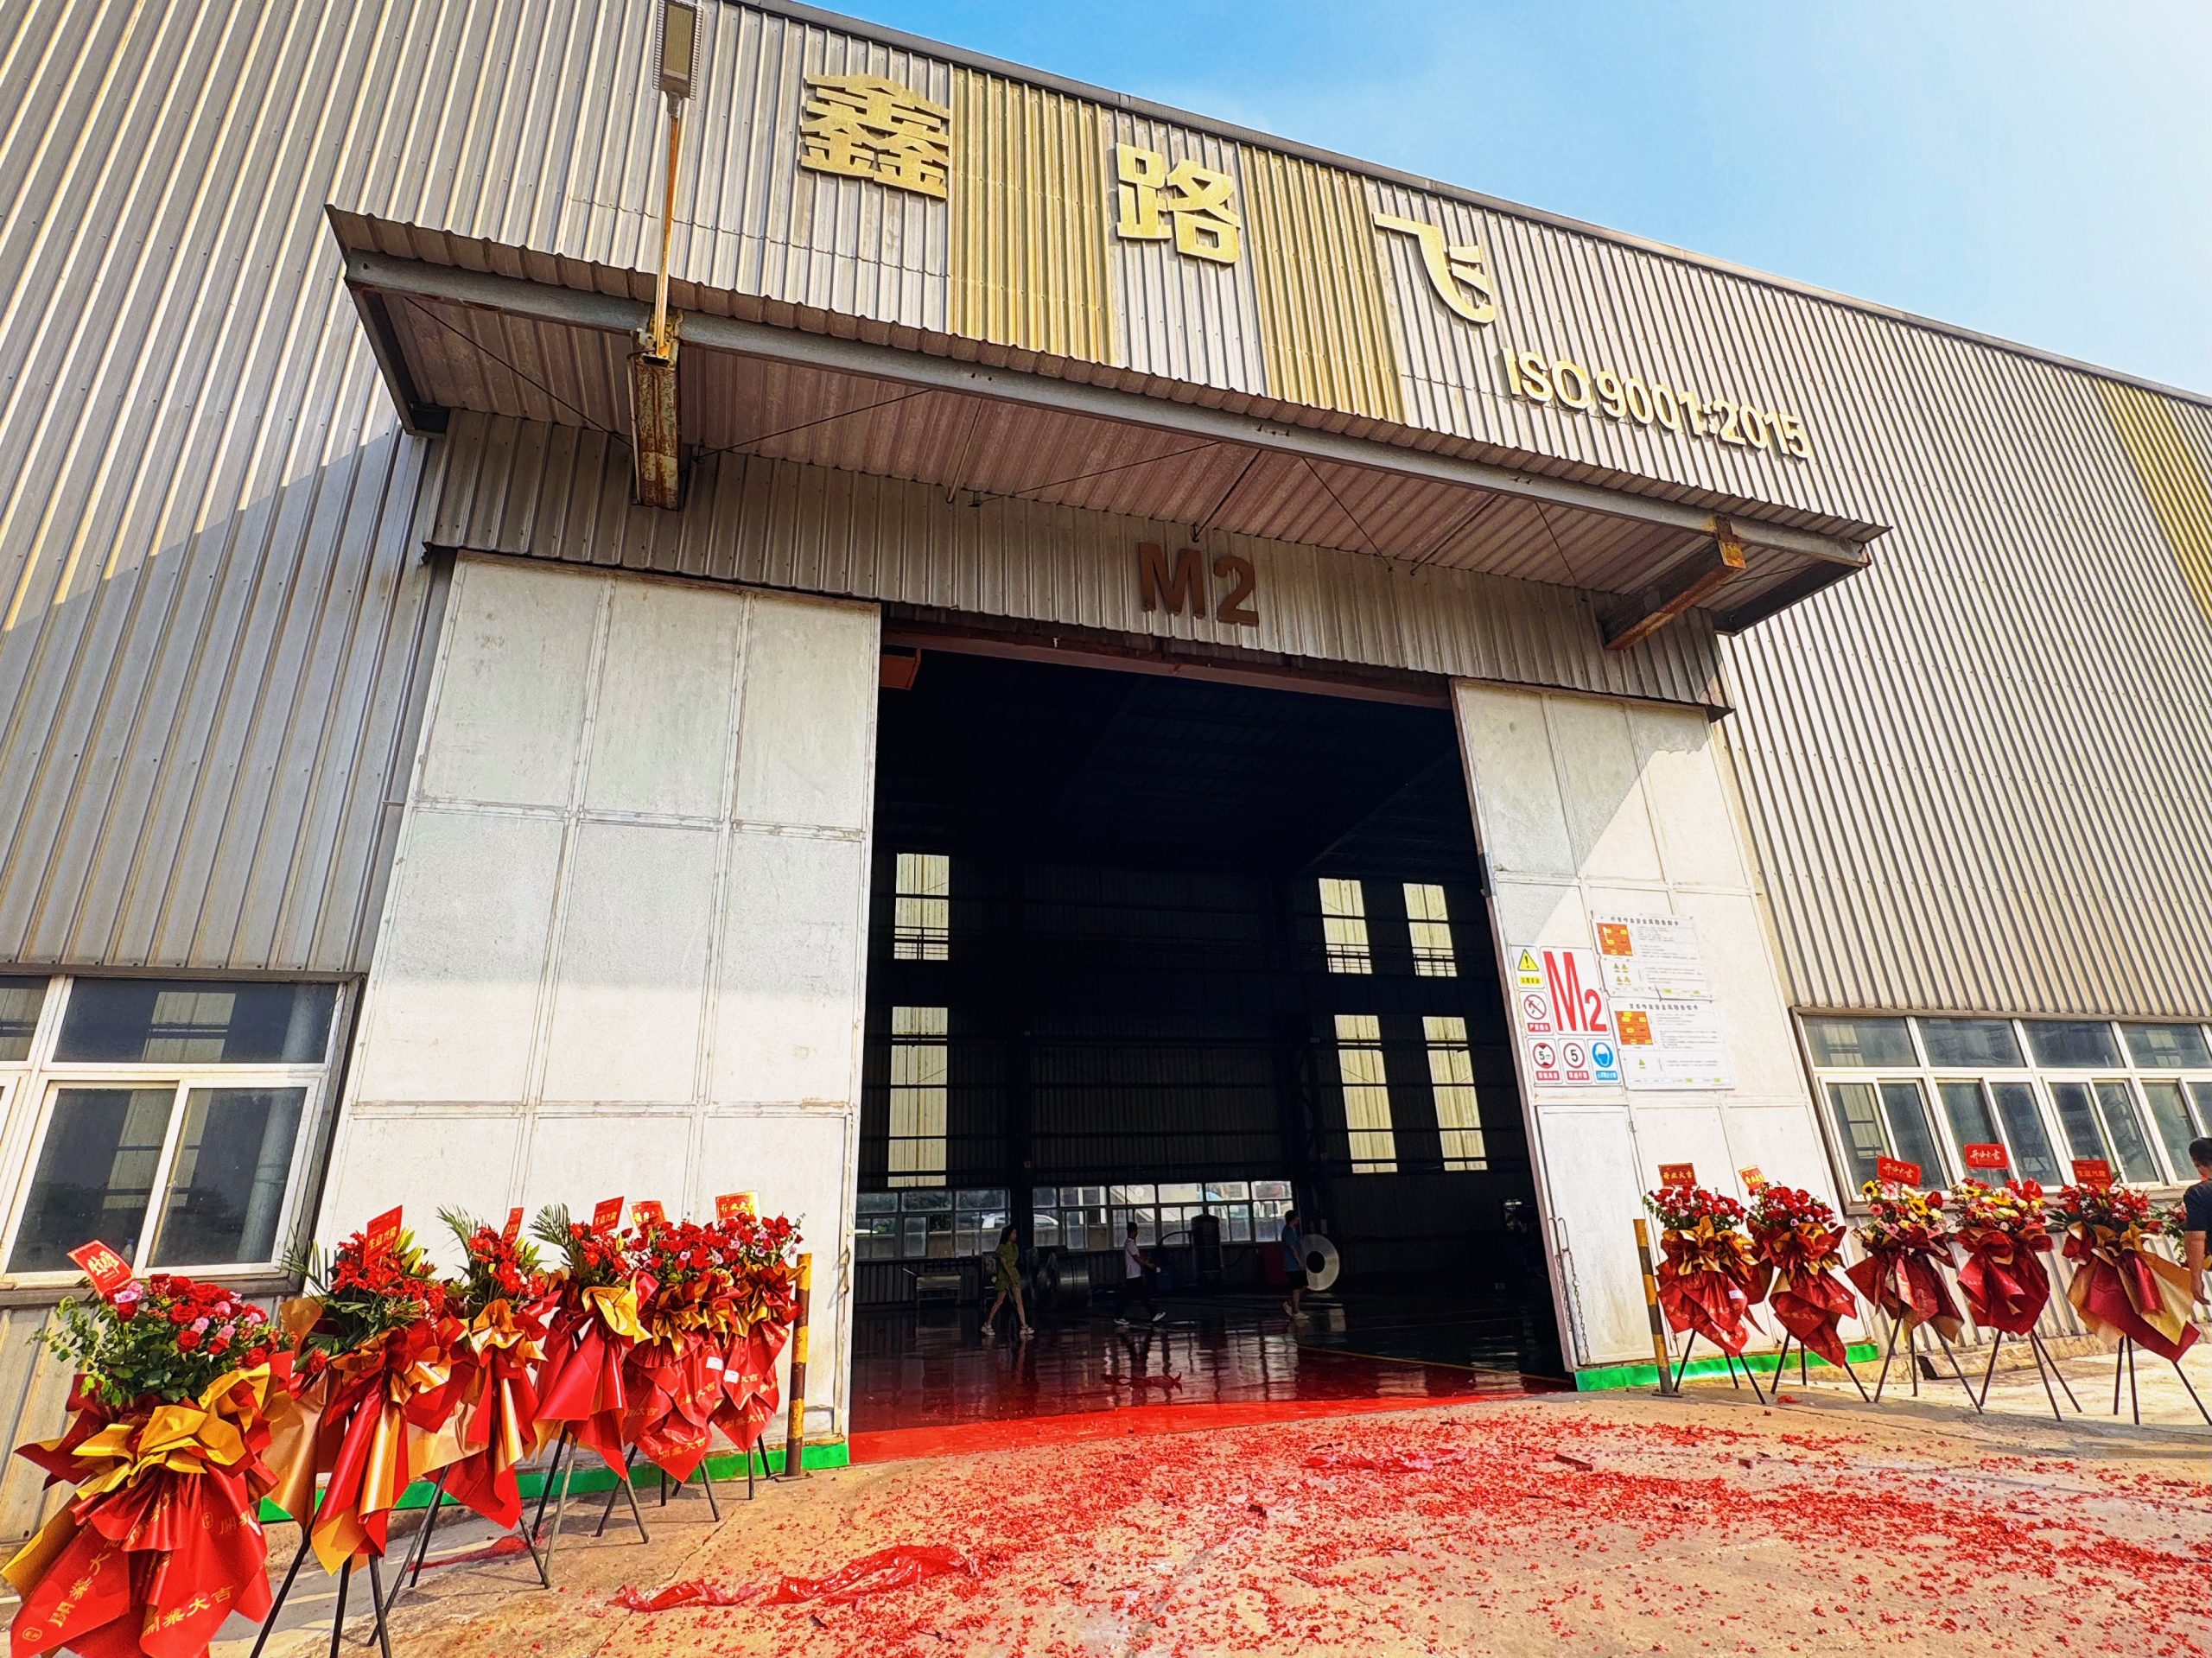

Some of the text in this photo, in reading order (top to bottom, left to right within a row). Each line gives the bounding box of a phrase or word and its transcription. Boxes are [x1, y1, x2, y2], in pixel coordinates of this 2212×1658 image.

[1502, 346, 1812, 459] ISO 9001:2015
[1138, 541, 1260, 627] M2
[1542, 950, 1608, 1032] M2
[1570, 1049, 1579, 1062] 5
